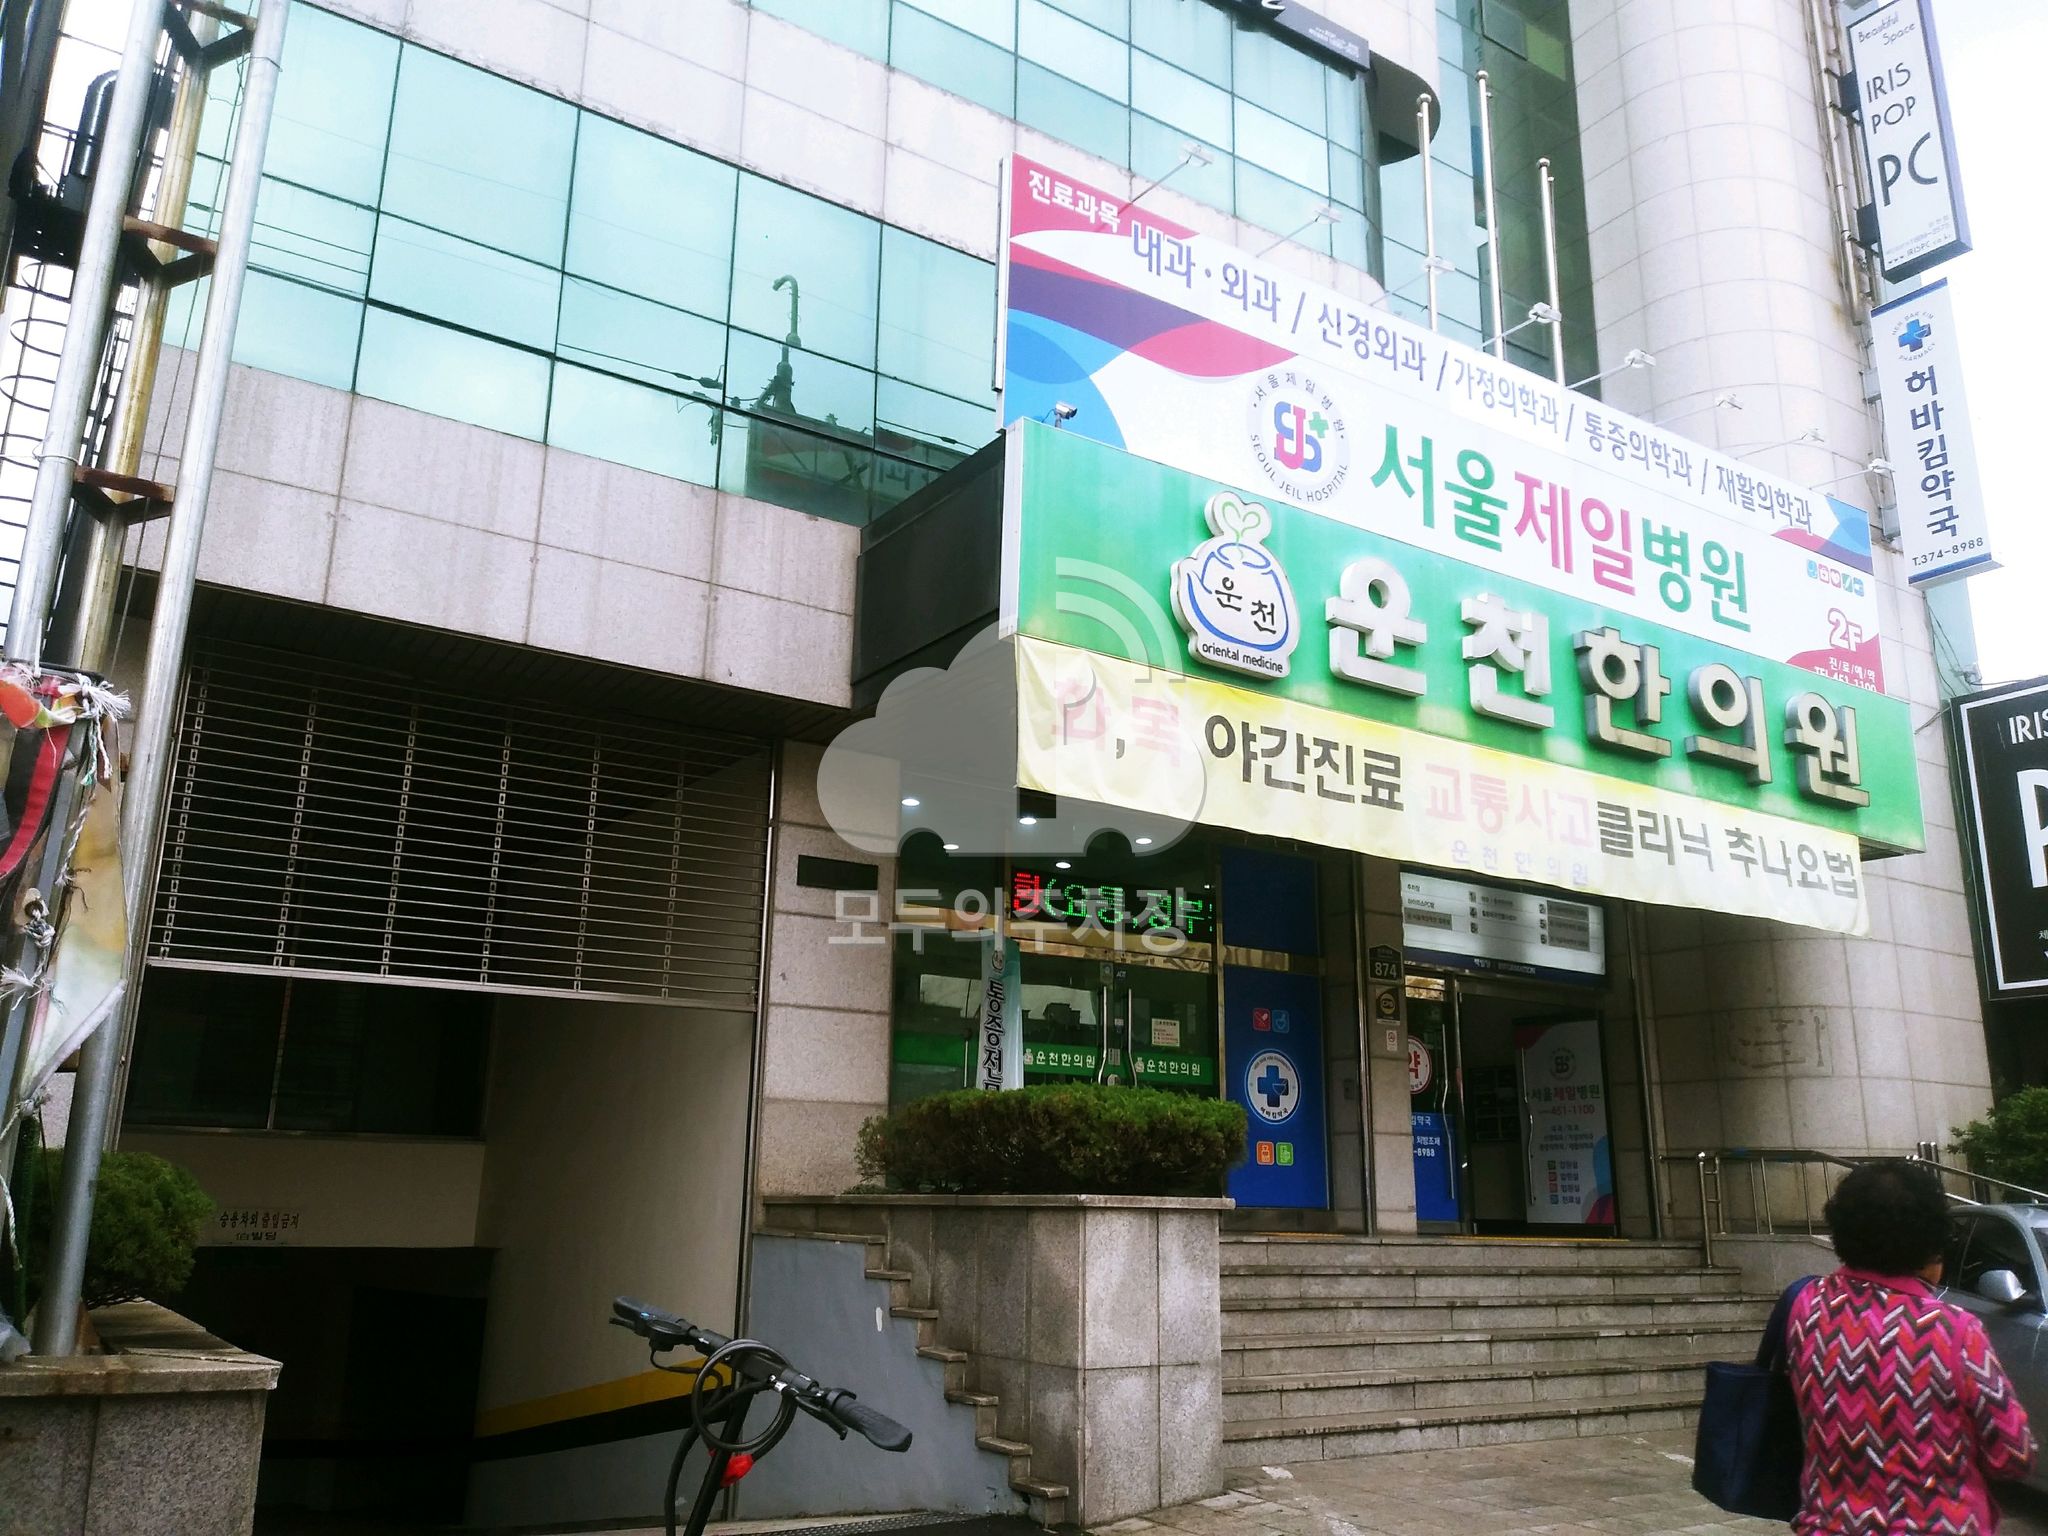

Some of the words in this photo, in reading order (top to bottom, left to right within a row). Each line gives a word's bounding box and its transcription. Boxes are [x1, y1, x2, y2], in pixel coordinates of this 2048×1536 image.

[1858, 14, 1899, 43] Beautiful
[1883, 22, 1916, 46] Space
[1866, 62, 1911, 103] IRIS
[1871, 96, 1916, 135] POP
[1877, 132, 1938, 207] PC
[1028, 169, 1121, 233] 진료과목
[1318, 302, 1427, 381] 신경외과
[1455, 357, 1560, 433] 가정의학과
[1584, 410, 1692, 487] 통증의학과
[1716, 462, 1813, 534] 재활의학과
[1251, 434, 1275, 482] SEOUL
[1279, 481, 1302, 500] JEIL
[1306, 464, 1348, 502] HOSPITAL
[1905, 365, 1959, 537] 허바킴약국
[1371, 424, 1751, 633] 서울제일병원
[1912, 537, 1984, 567] T.374-8988
[1214, 576, 1277, 635] 운천
[1828, 608, 1863, 653] 2F
[1202, 642, 1240, 663] oriental
[1242, 653, 1284, 674] medicine
[1325, 555, 1869, 809] 운천한의원
[1204, 714, 1404, 811] 야간진료
[1724, 827, 1858, 900] 추나요법
[1451, 839, 1589, 886] 운천한의원
[1375, 962, 1397, 979] 874
[1035, 1049, 1096, 1069] 운천한의원
[1146, 1058, 1201, 1077] 운천한의원
